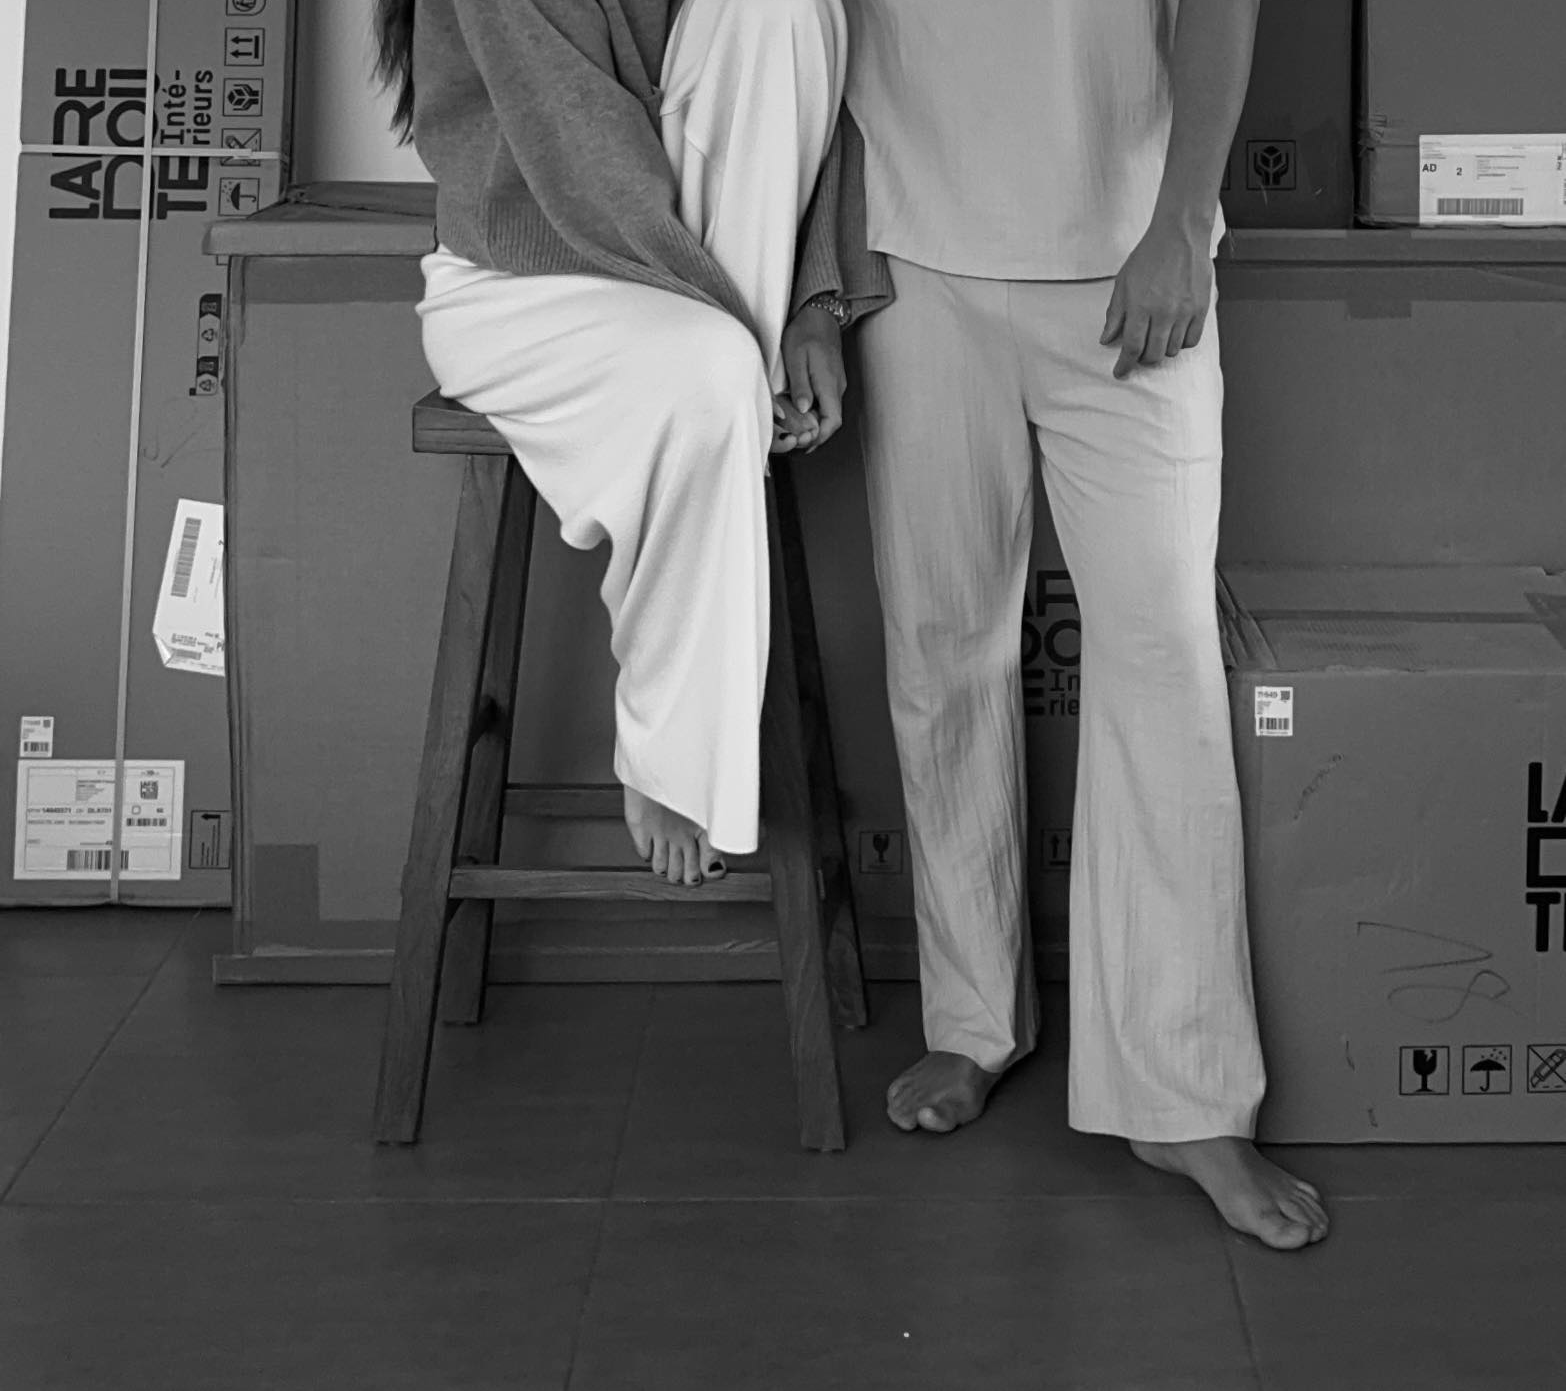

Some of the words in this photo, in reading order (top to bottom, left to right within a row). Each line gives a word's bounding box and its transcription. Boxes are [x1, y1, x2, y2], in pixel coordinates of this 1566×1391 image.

[49, 68, 107, 220] LARE
[160, 70, 187, 145] Inté-
[186, 69, 214, 145] rieurs
[156, 155, 210, 220] TE
